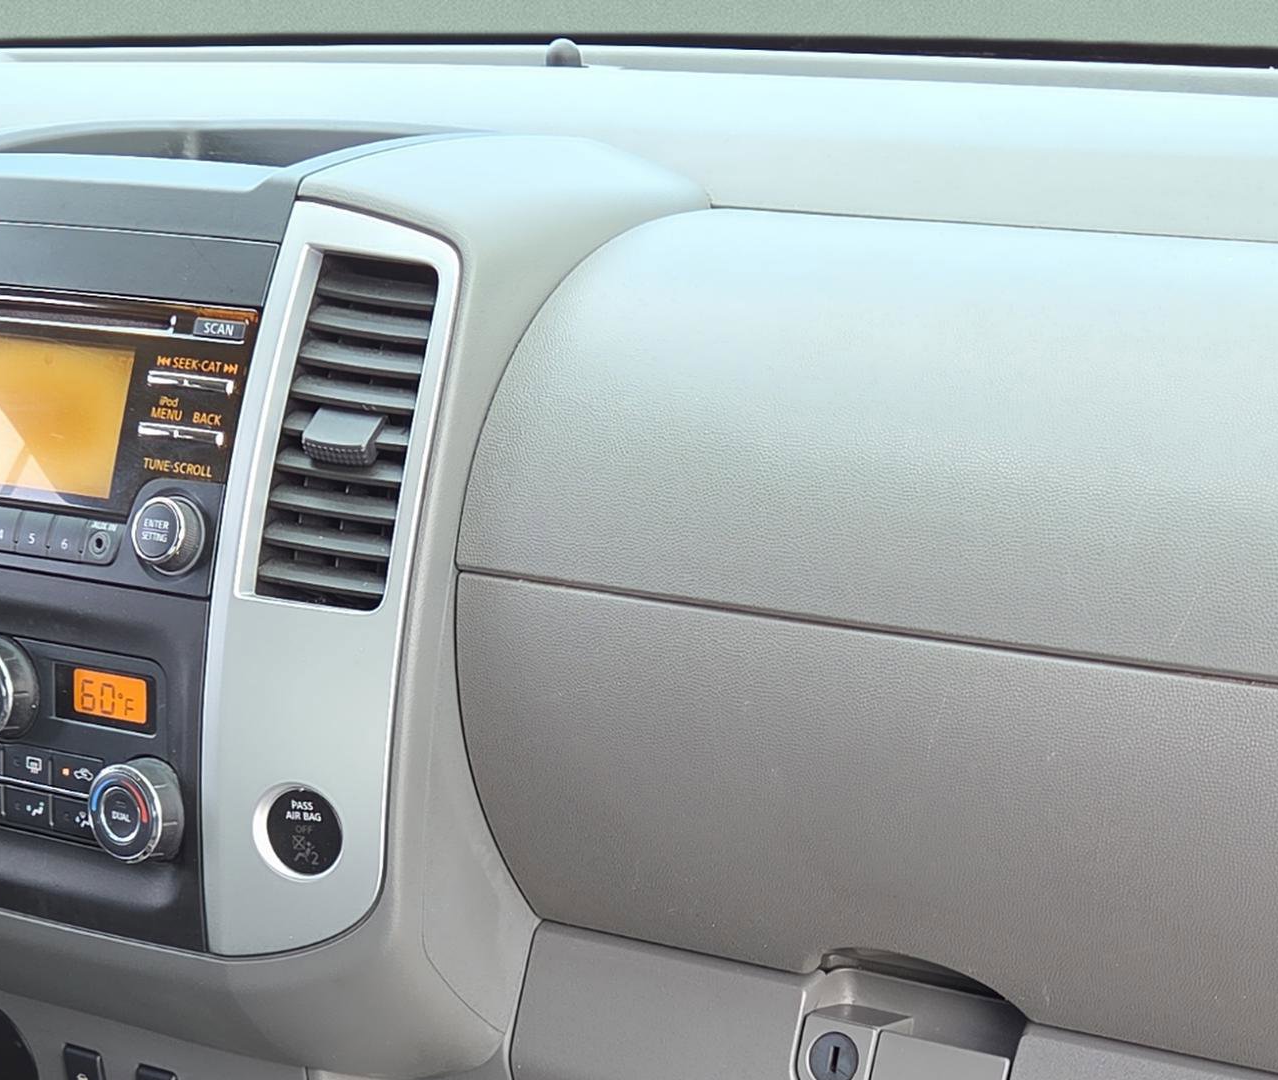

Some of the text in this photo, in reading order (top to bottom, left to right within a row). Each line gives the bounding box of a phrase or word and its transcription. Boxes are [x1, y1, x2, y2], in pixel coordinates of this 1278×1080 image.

[203, 322, 234, 336] SCAN
[150, 407, 222, 426] MENU BACK
[143, 518, 170, 530] ENTER
[28, 532, 36, 545] 5
[60, 538, 69, 550] 6
[291, 799, 314, 811] PASS
[285, 810, 322, 822] AIR BAG
[294, 825, 314, 835] OFF
[311, 851, 320, 865] 2
